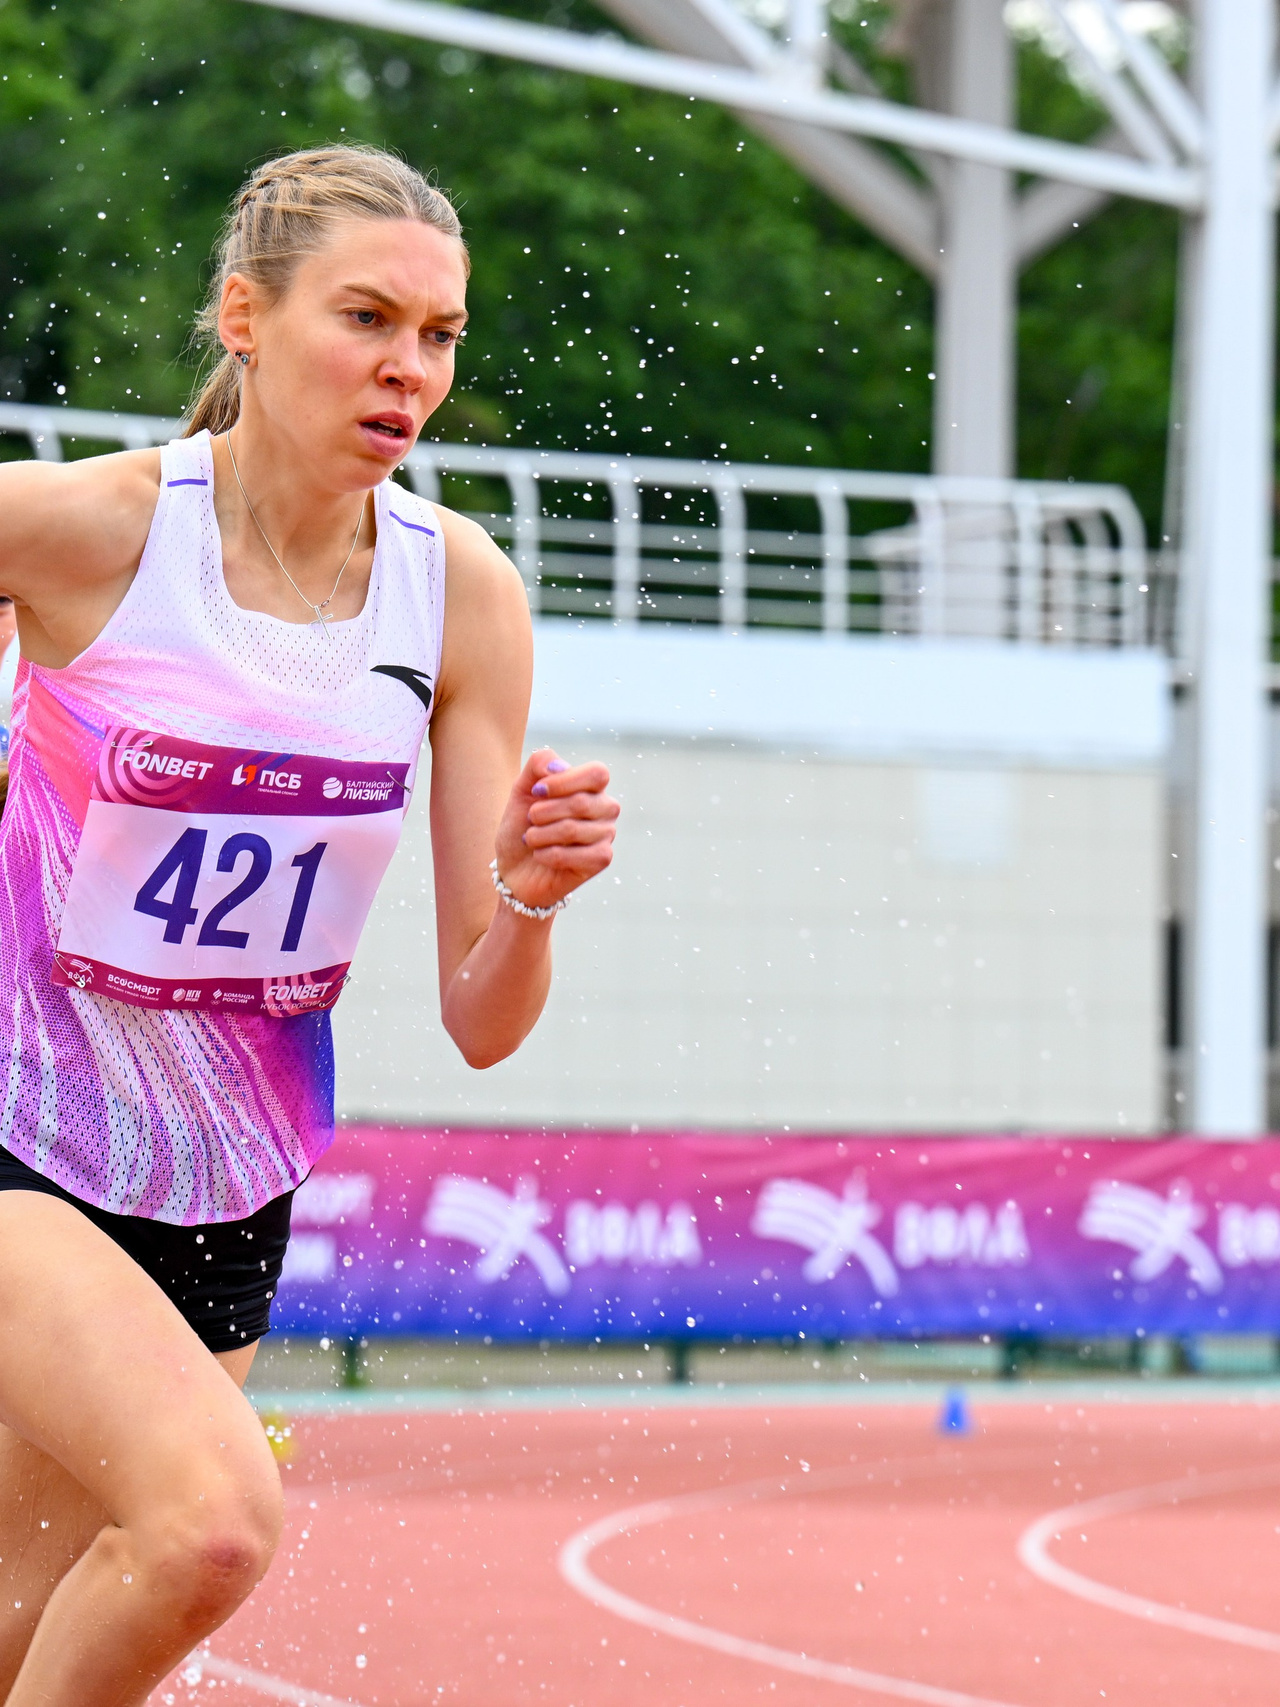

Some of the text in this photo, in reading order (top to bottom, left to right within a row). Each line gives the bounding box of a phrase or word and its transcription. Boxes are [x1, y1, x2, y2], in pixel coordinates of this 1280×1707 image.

[118, 749, 213, 780] FONBET
[259, 769, 302, 789] ПСБ
[343, 788, 393, 801] ЛИЗИНГ
[133, 827, 328, 952] 421
[263, 982, 333, 1001] FONBET
